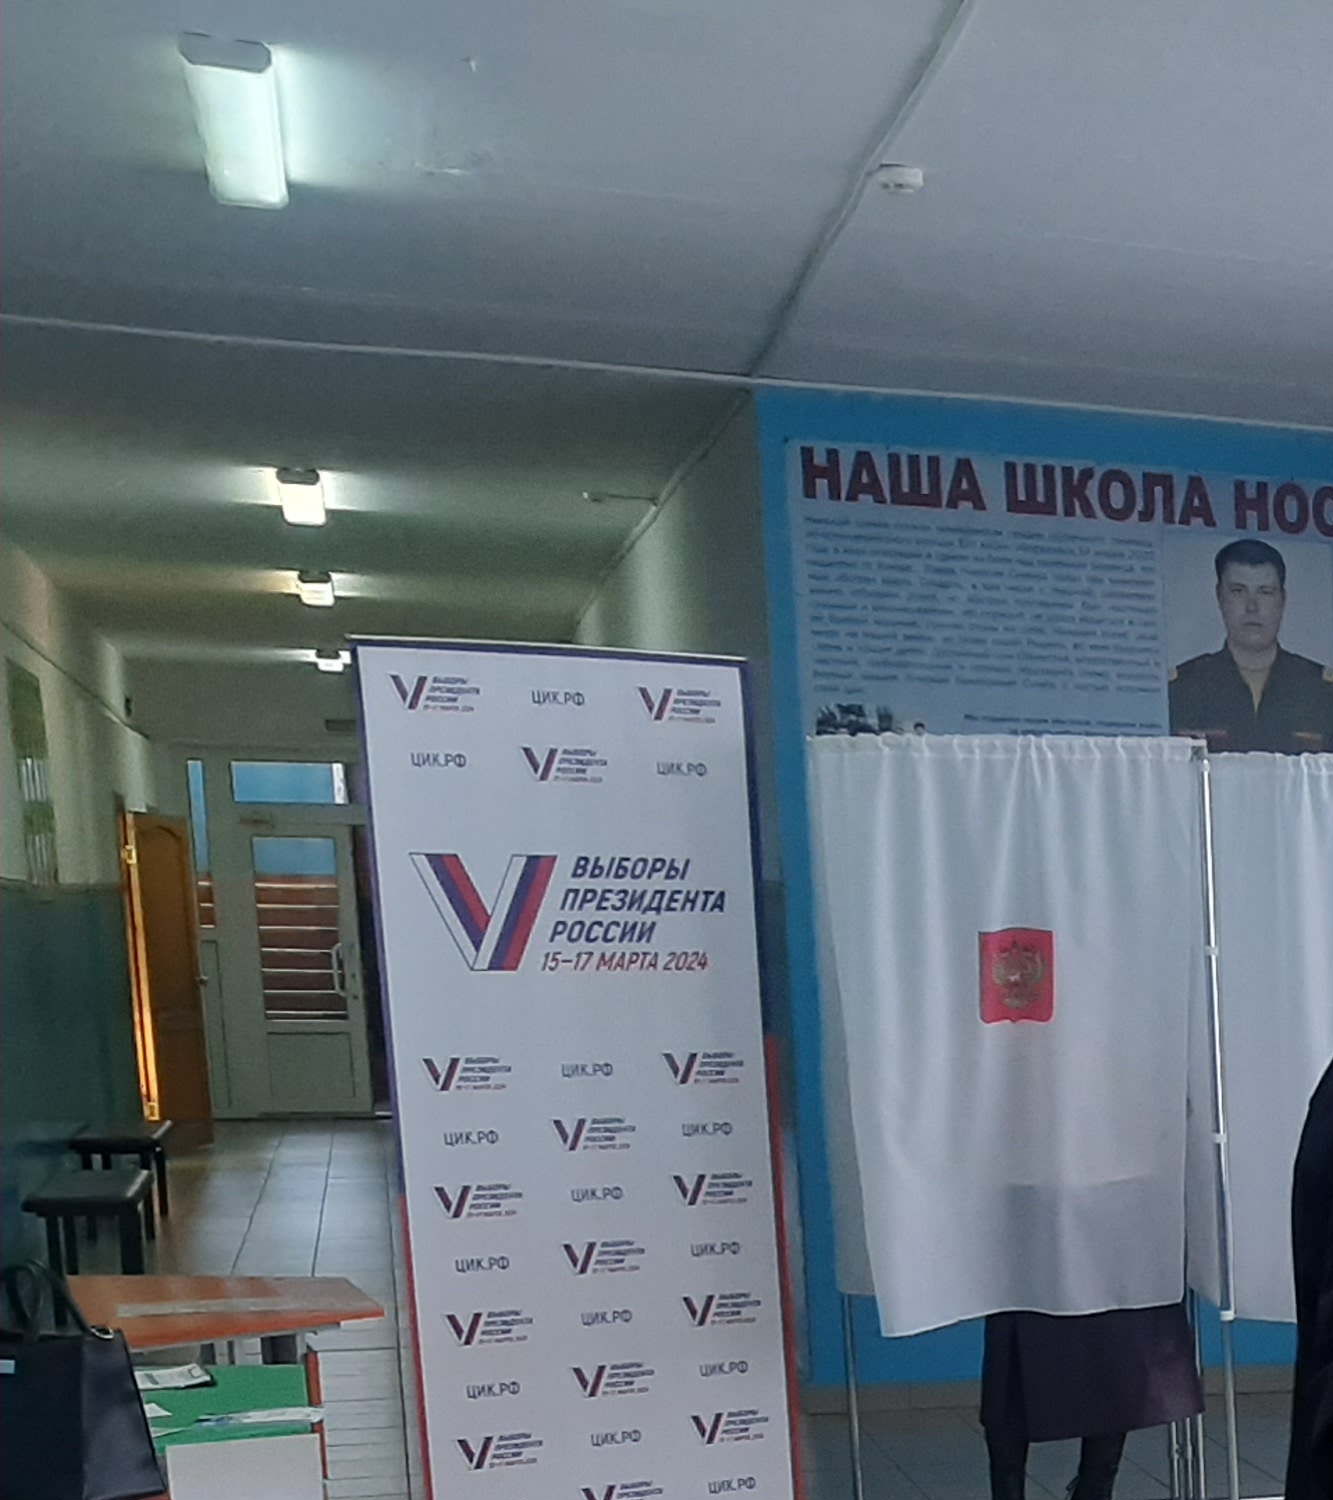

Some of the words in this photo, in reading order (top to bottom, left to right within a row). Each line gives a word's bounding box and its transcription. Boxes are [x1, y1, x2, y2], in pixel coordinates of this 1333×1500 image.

[800, 446, 987, 511] НАША
[1004, 461, 1217, 527] ШКОЛА
[570, 856, 691, 881] ВЫБОРЫ
[559, 888, 726, 915] ПРЕЗИДЕНТА
[549, 920, 656, 944] РОССИИ
[596, 953, 659, 972] МАРТА
[663, 951, 709, 972] 2024
